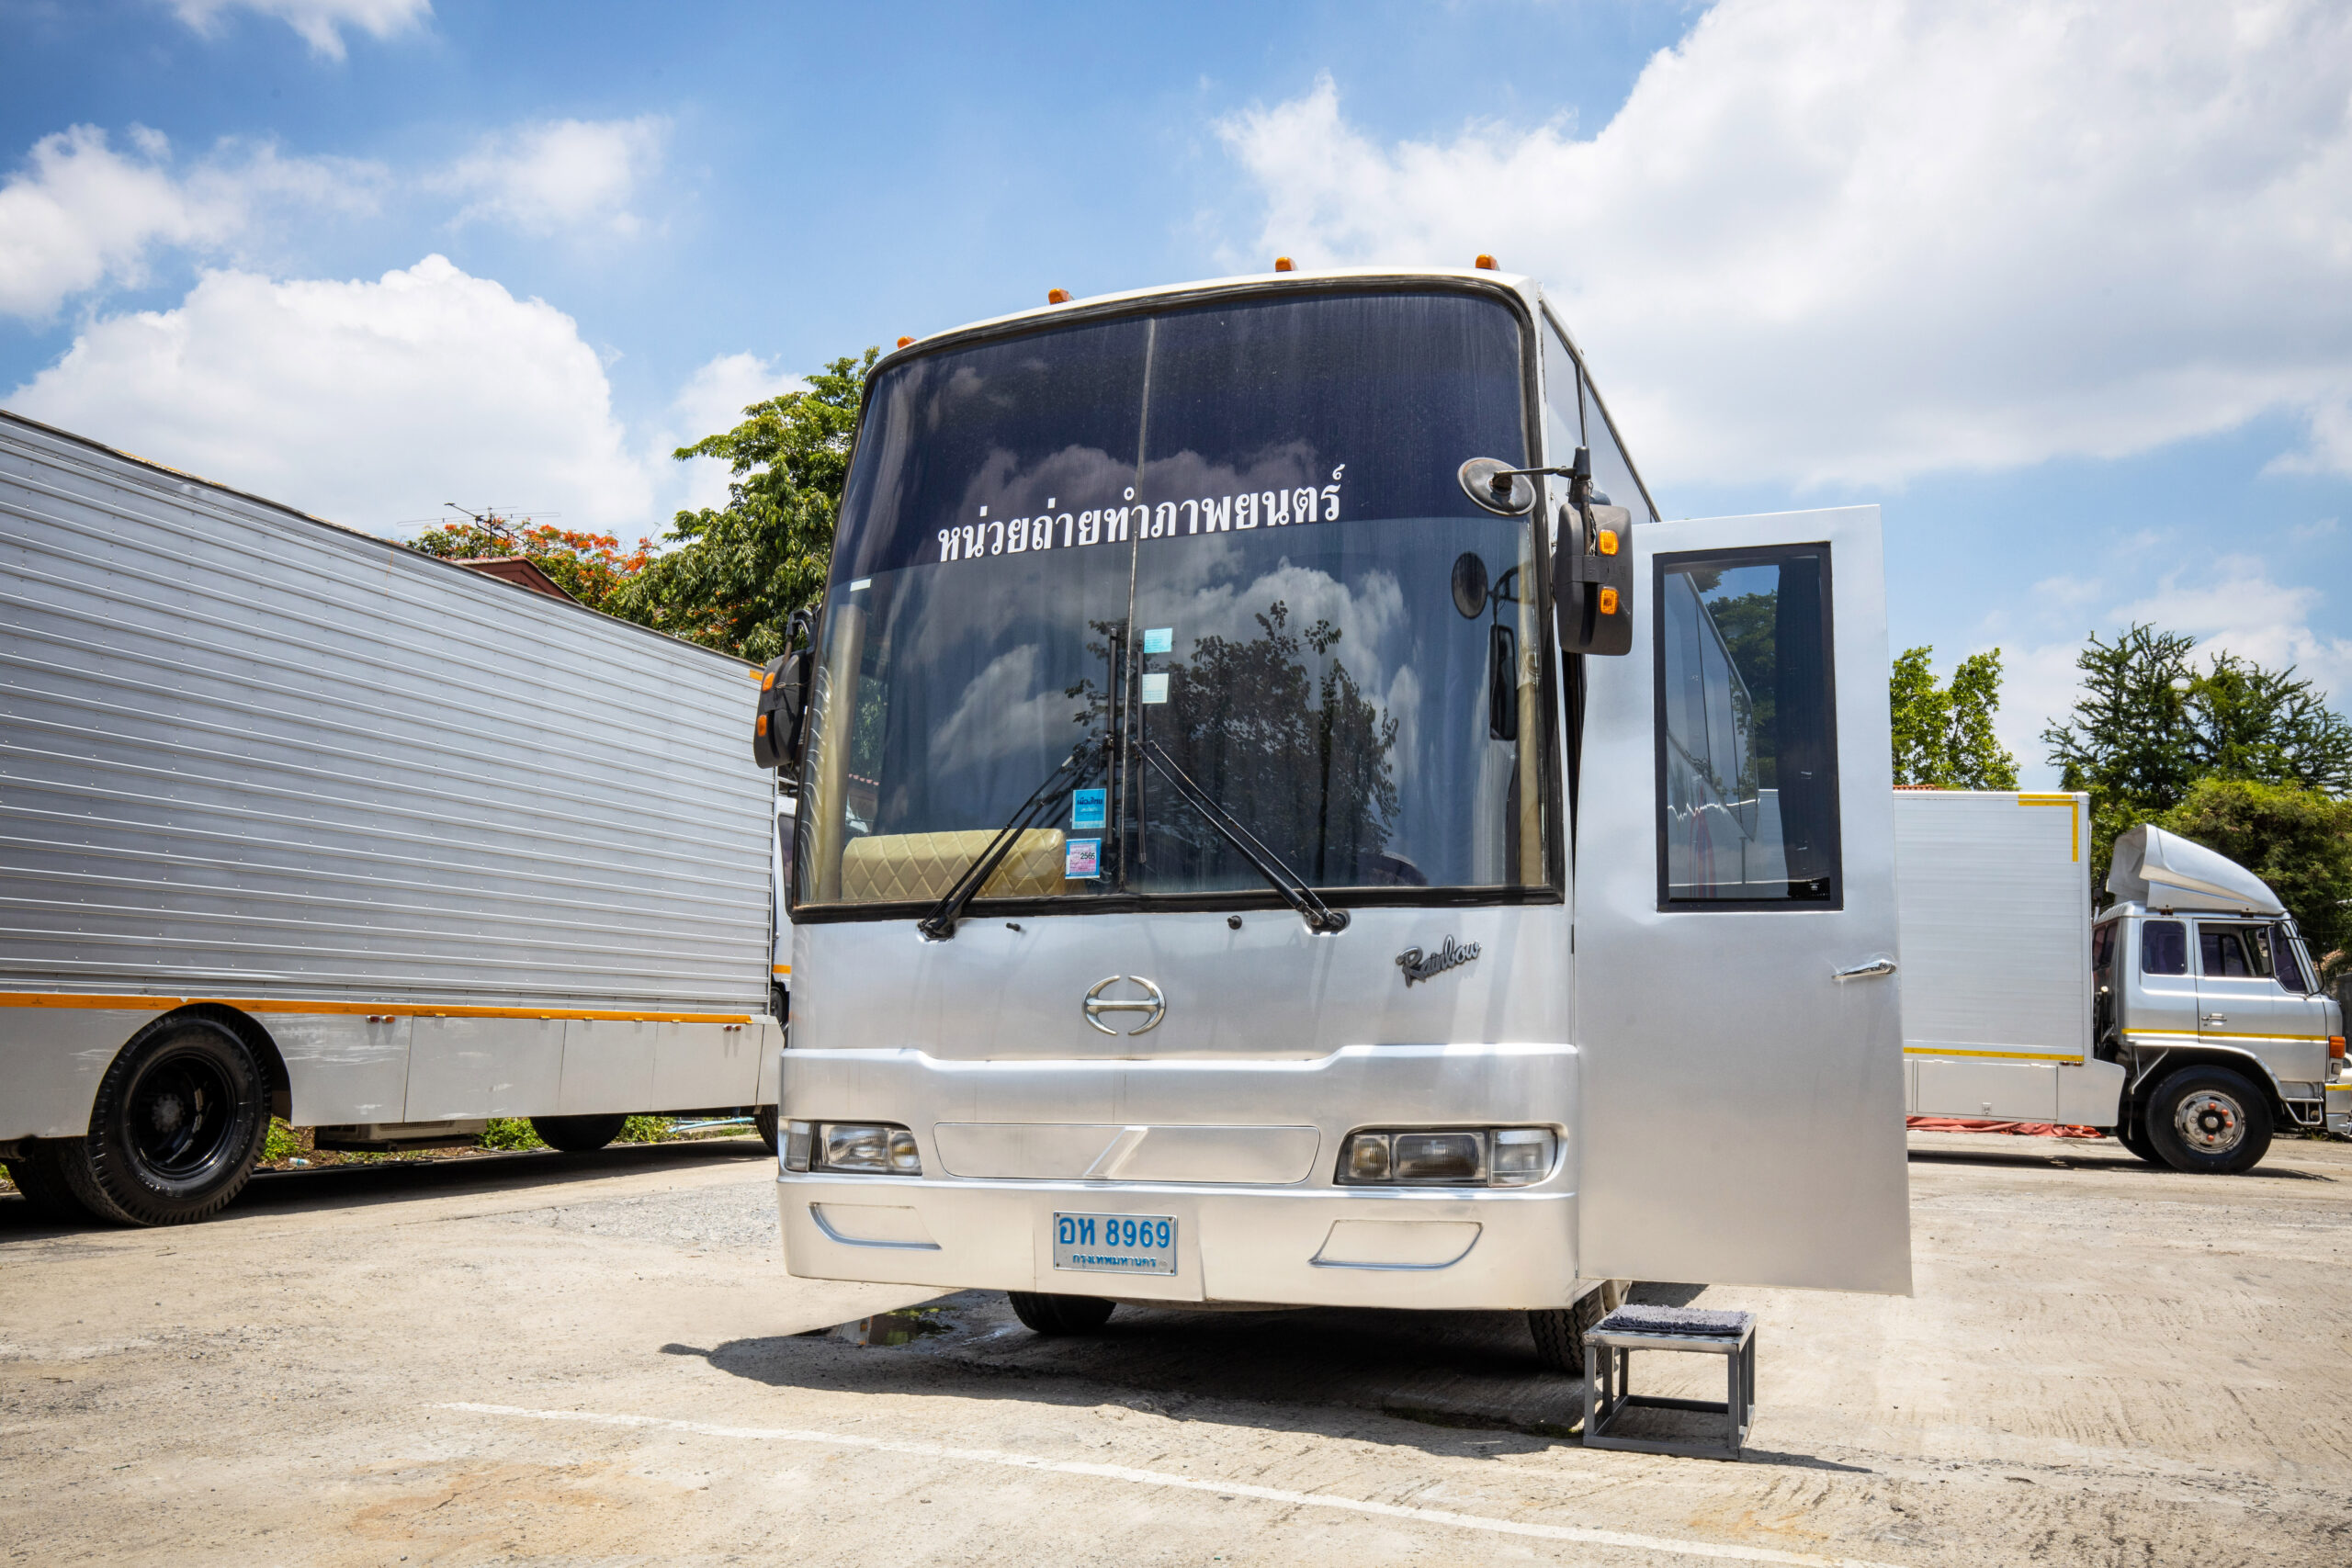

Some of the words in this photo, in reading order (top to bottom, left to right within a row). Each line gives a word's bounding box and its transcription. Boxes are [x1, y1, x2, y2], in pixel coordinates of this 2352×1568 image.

[938, 464, 1345, 562] หน่วยถ่ายทำภาพยนตร์
[1396, 934, 1482, 988] Rainbow
[1105, 1218, 1170, 1248] 8969
[1072, 1253, 1157, 1269] กรุงเทพมหานคร
